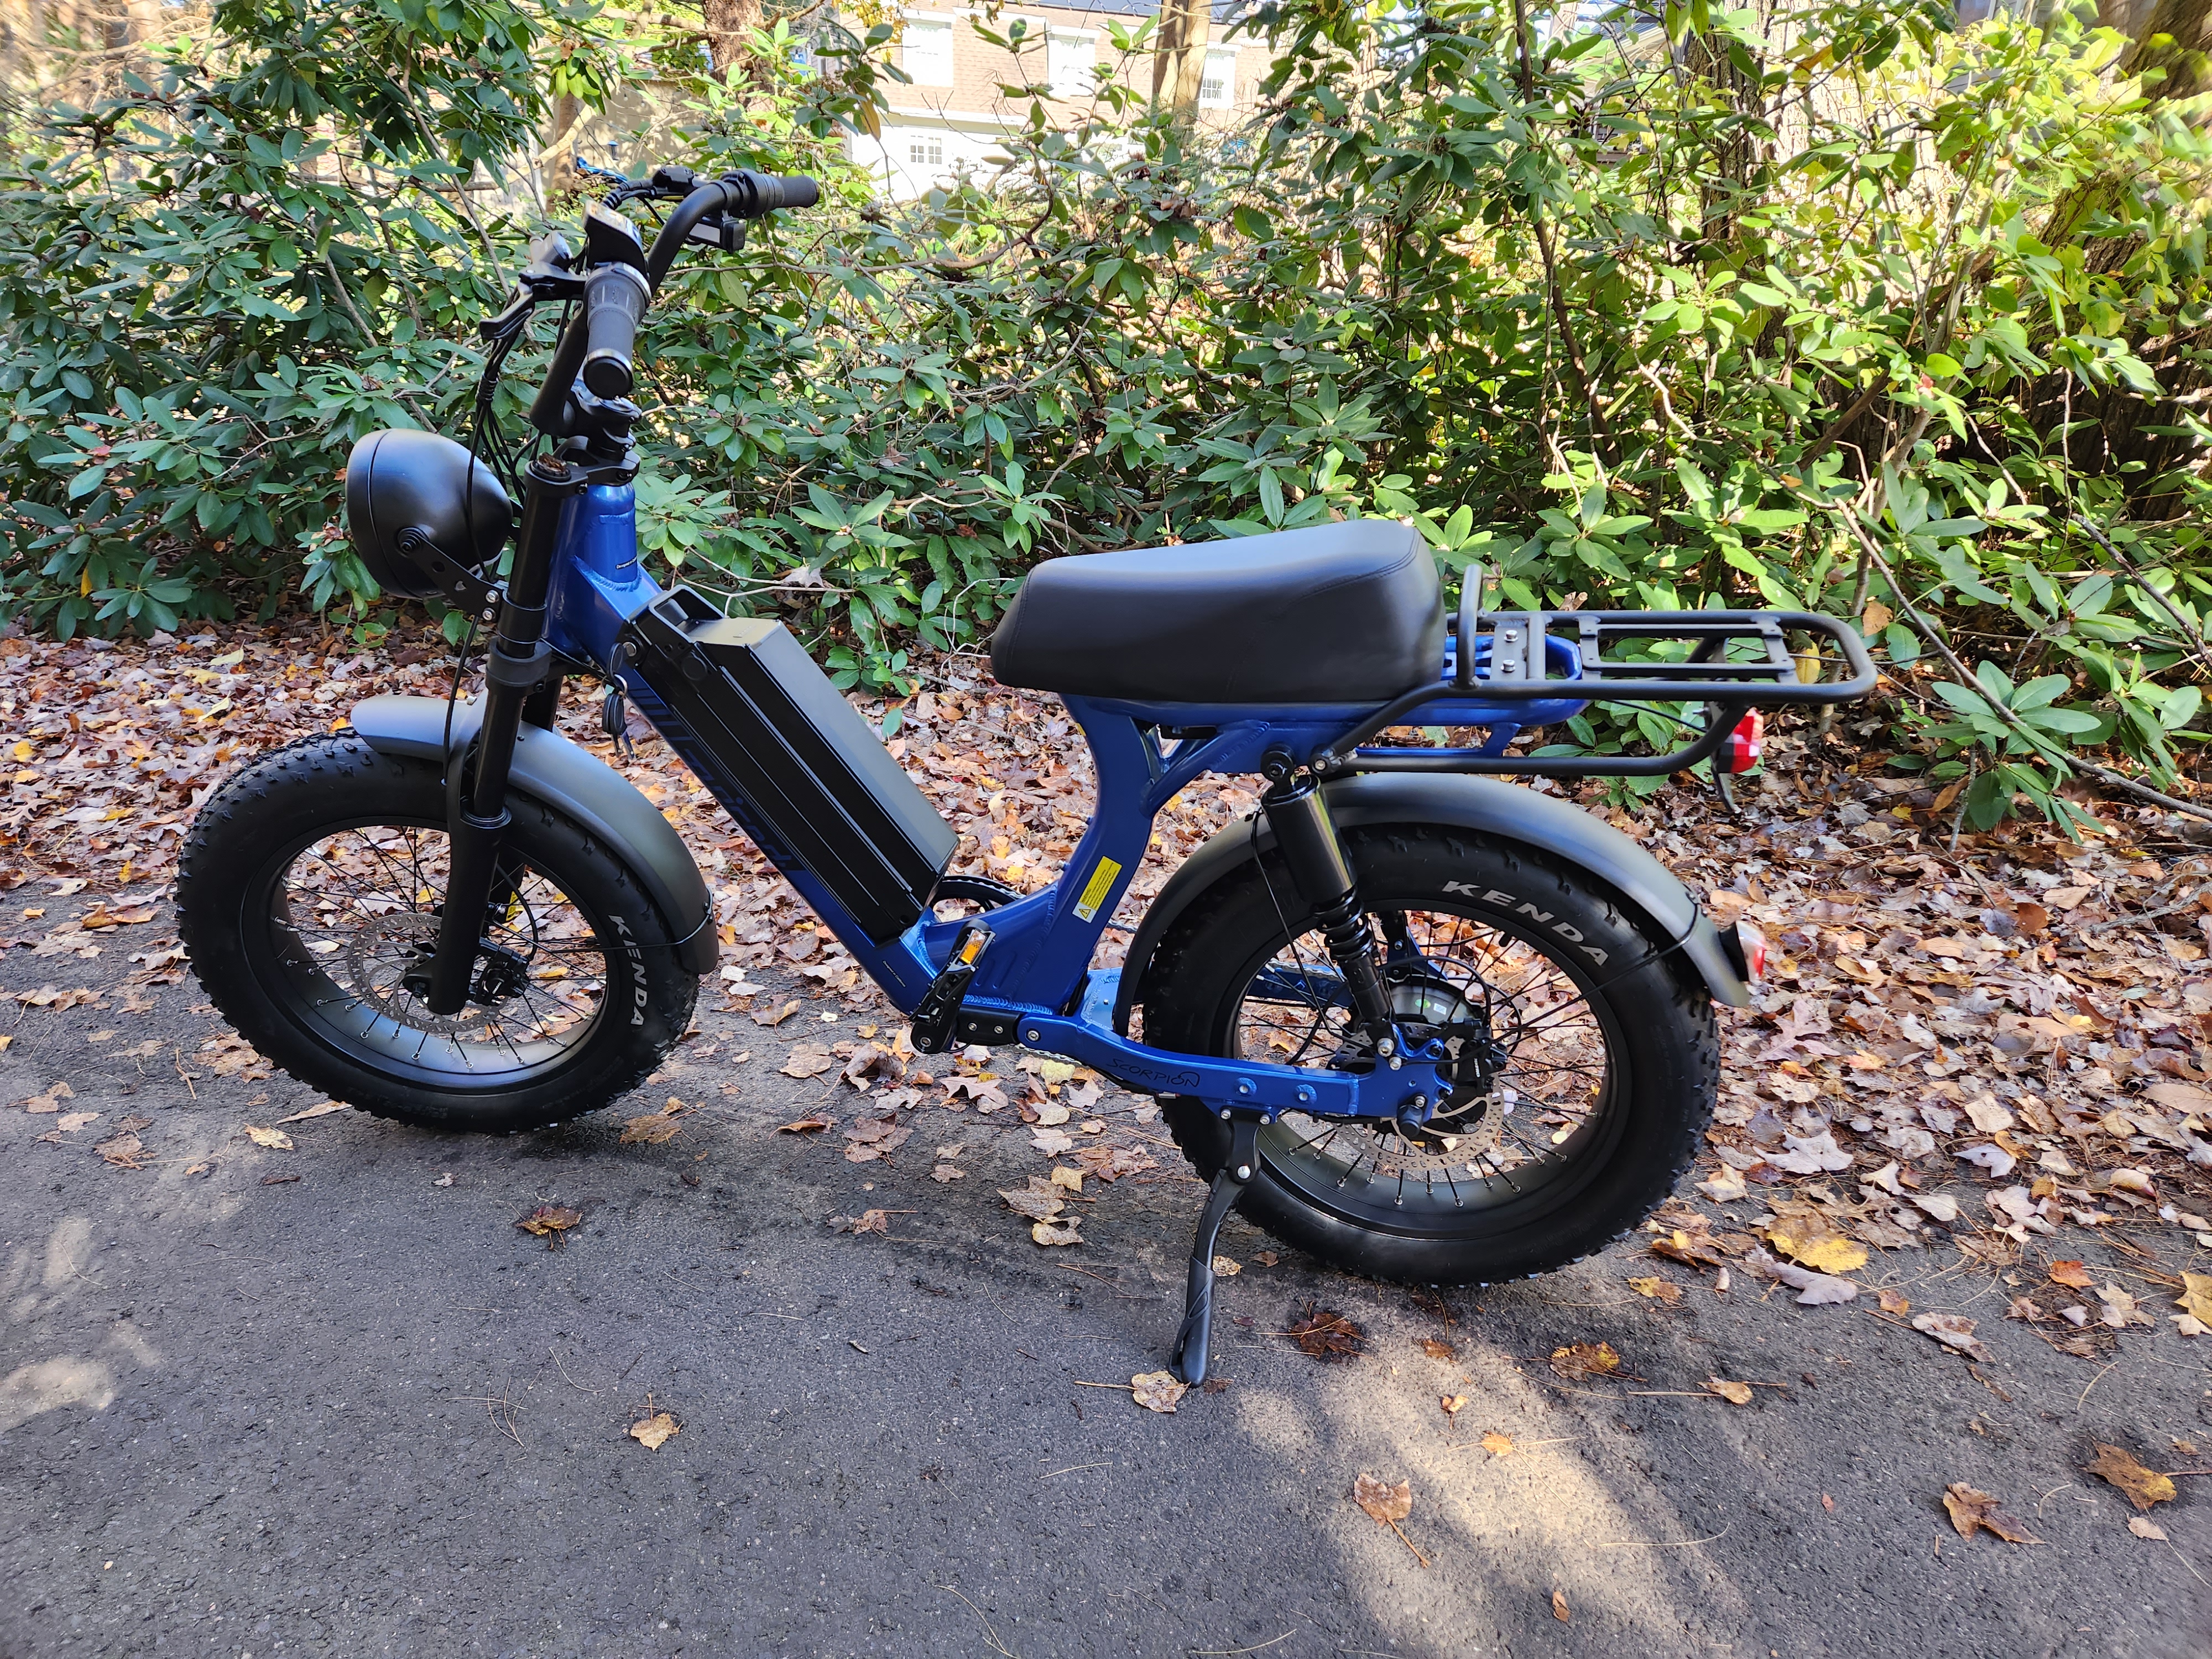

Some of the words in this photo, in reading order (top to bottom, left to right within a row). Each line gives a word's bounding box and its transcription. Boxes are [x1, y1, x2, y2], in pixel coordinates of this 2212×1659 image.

[1442, 880, 1609, 967] KENDA
[608, 915, 648, 1025] KENDA
[1107, 1058, 1201, 1088] SCORPION
